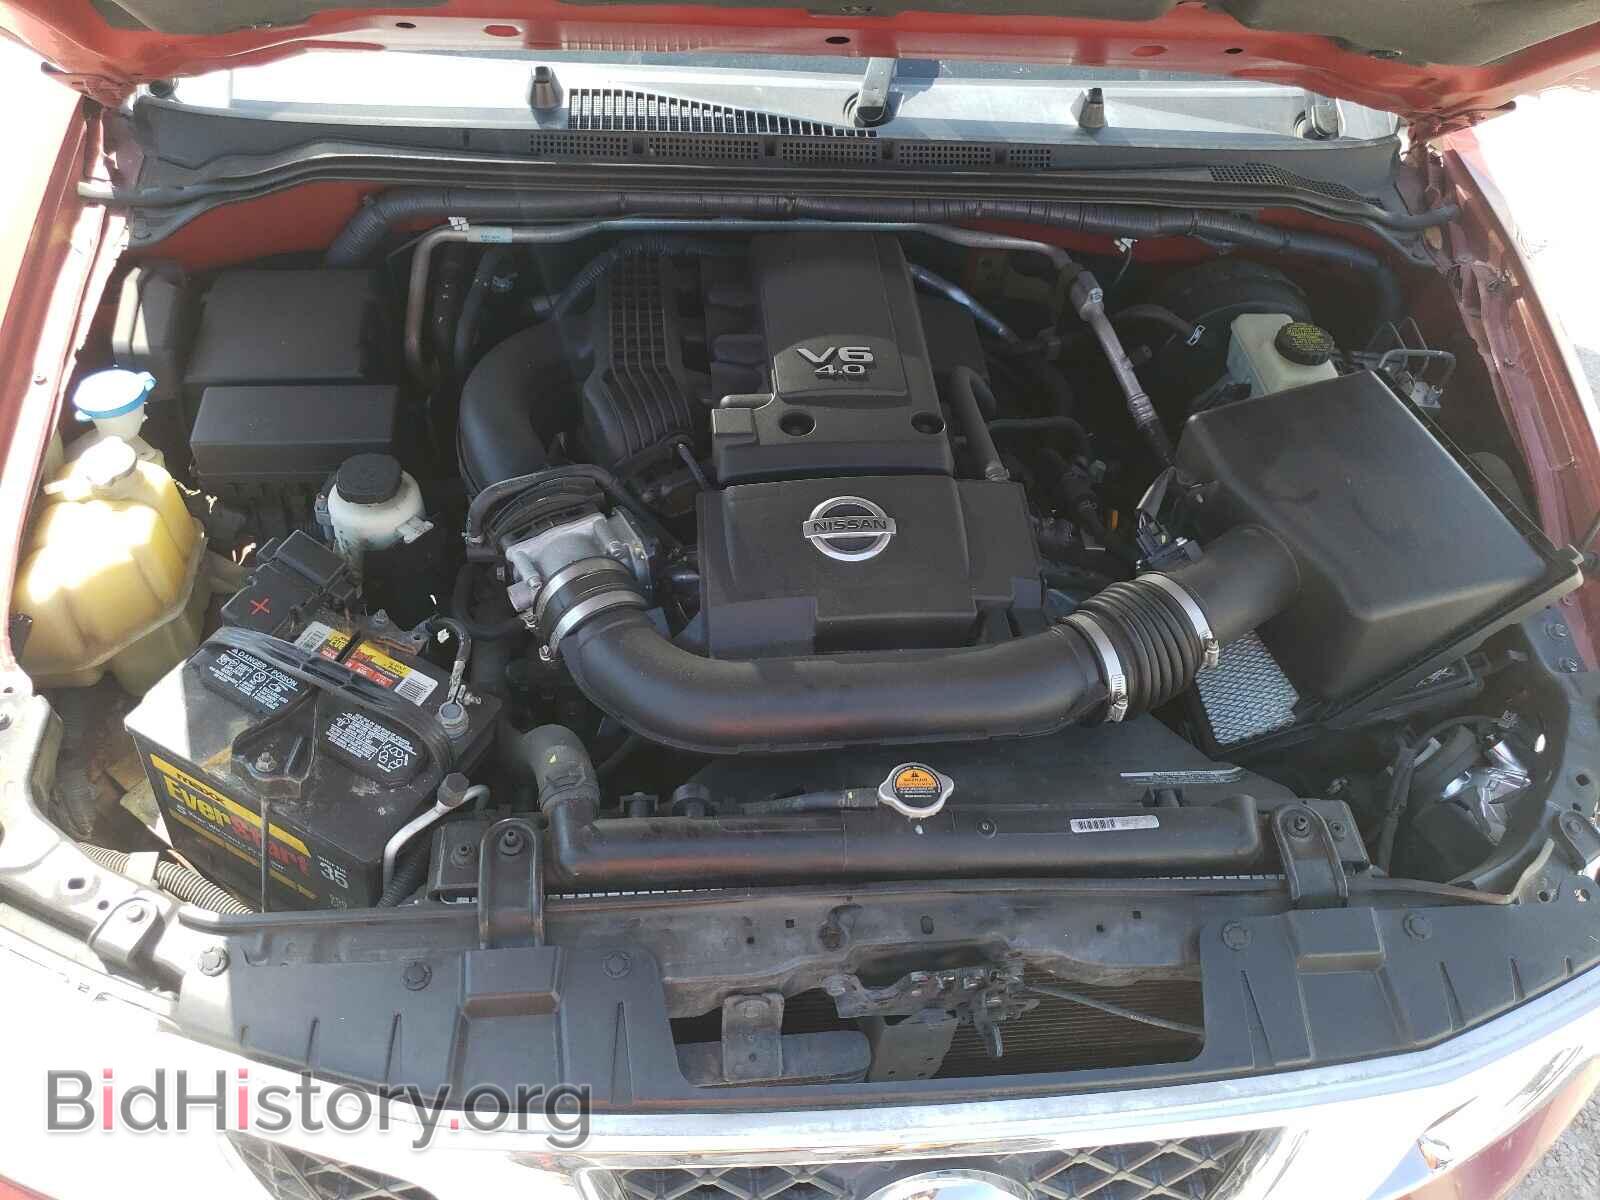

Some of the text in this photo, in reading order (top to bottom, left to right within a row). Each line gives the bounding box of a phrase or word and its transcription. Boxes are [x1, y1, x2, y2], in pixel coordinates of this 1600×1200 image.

[797, 346, 874, 363] V6
[814, 364, 866, 374] 4.0
[813, 519, 888, 533] NISSAN
[238, 650, 267, 669] DANGER
[270, 669, 298, 687] POISON
[320, 861, 349, 889] 35
